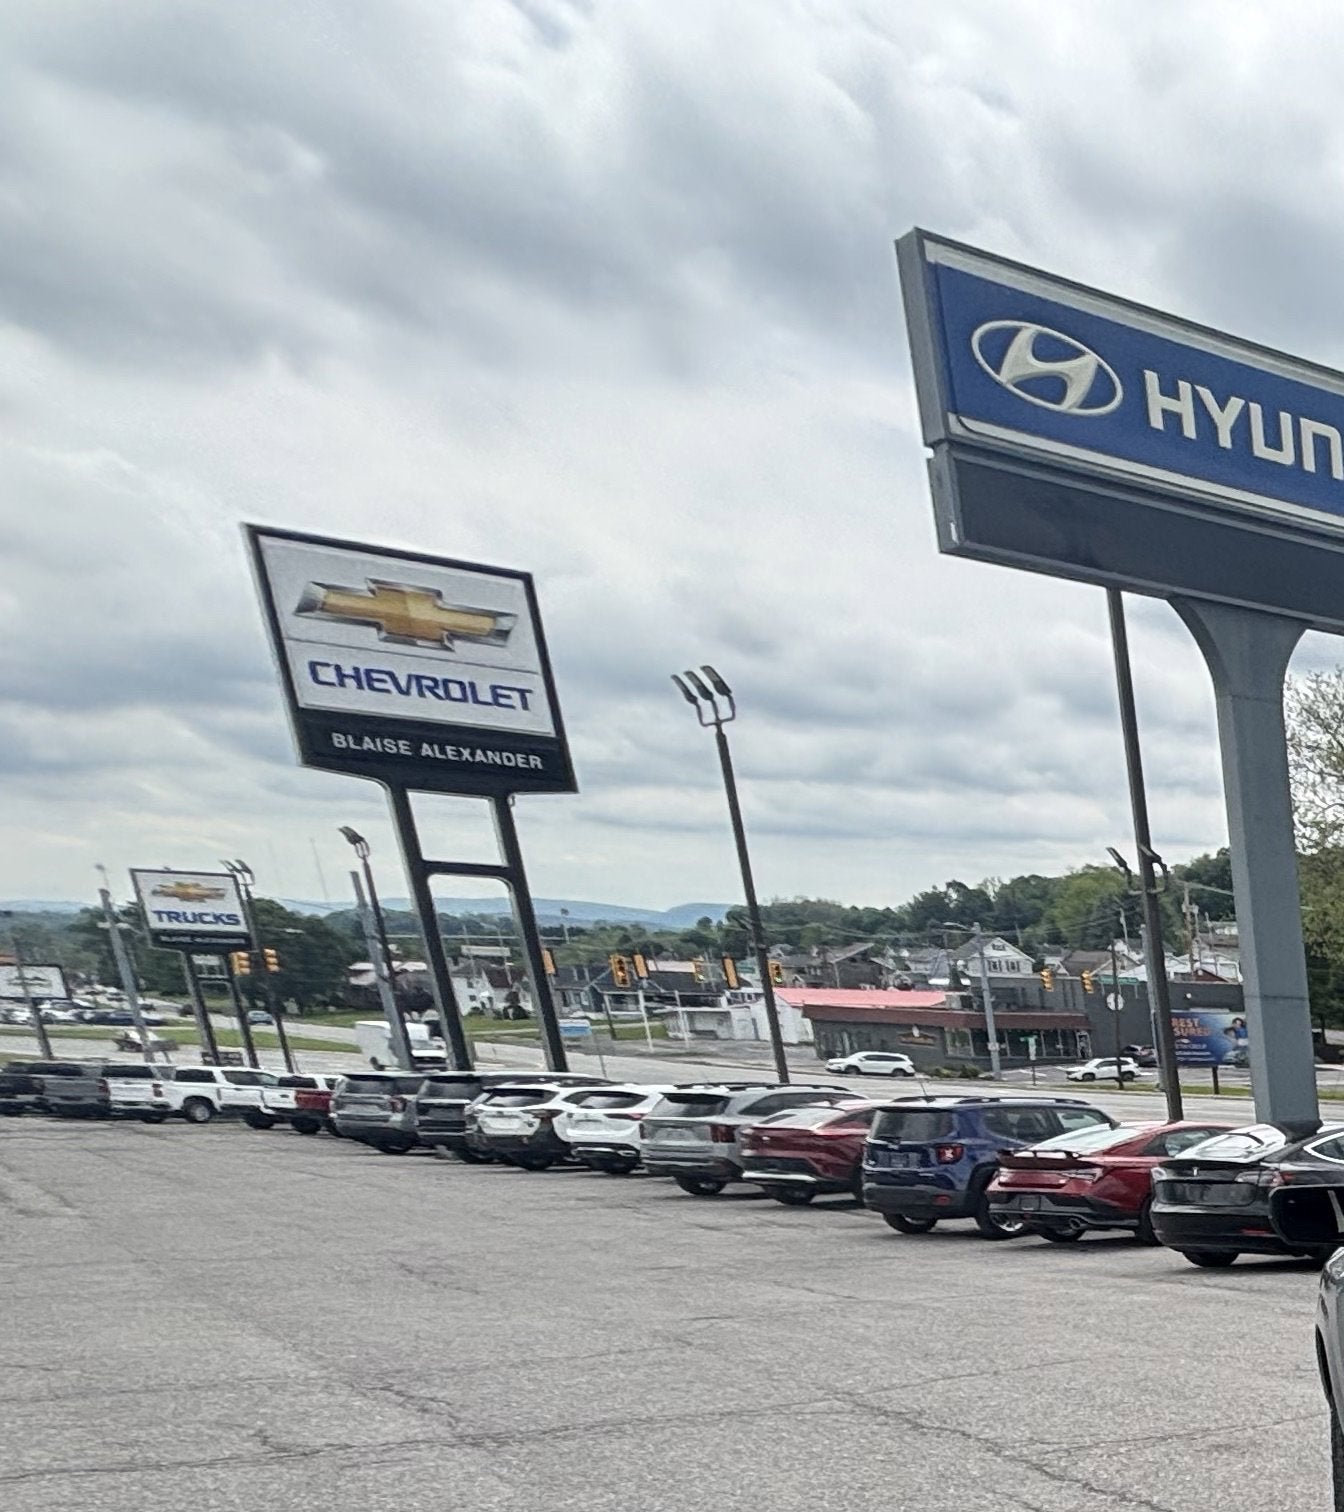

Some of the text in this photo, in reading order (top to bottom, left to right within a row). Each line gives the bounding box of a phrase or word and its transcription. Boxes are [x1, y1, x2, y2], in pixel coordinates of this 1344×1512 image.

[308, 660, 534, 711] CHEVROLET
[330, 732, 544, 770] BLAISE ALEXANDER
[150, 909, 242, 925] TRUCKS
